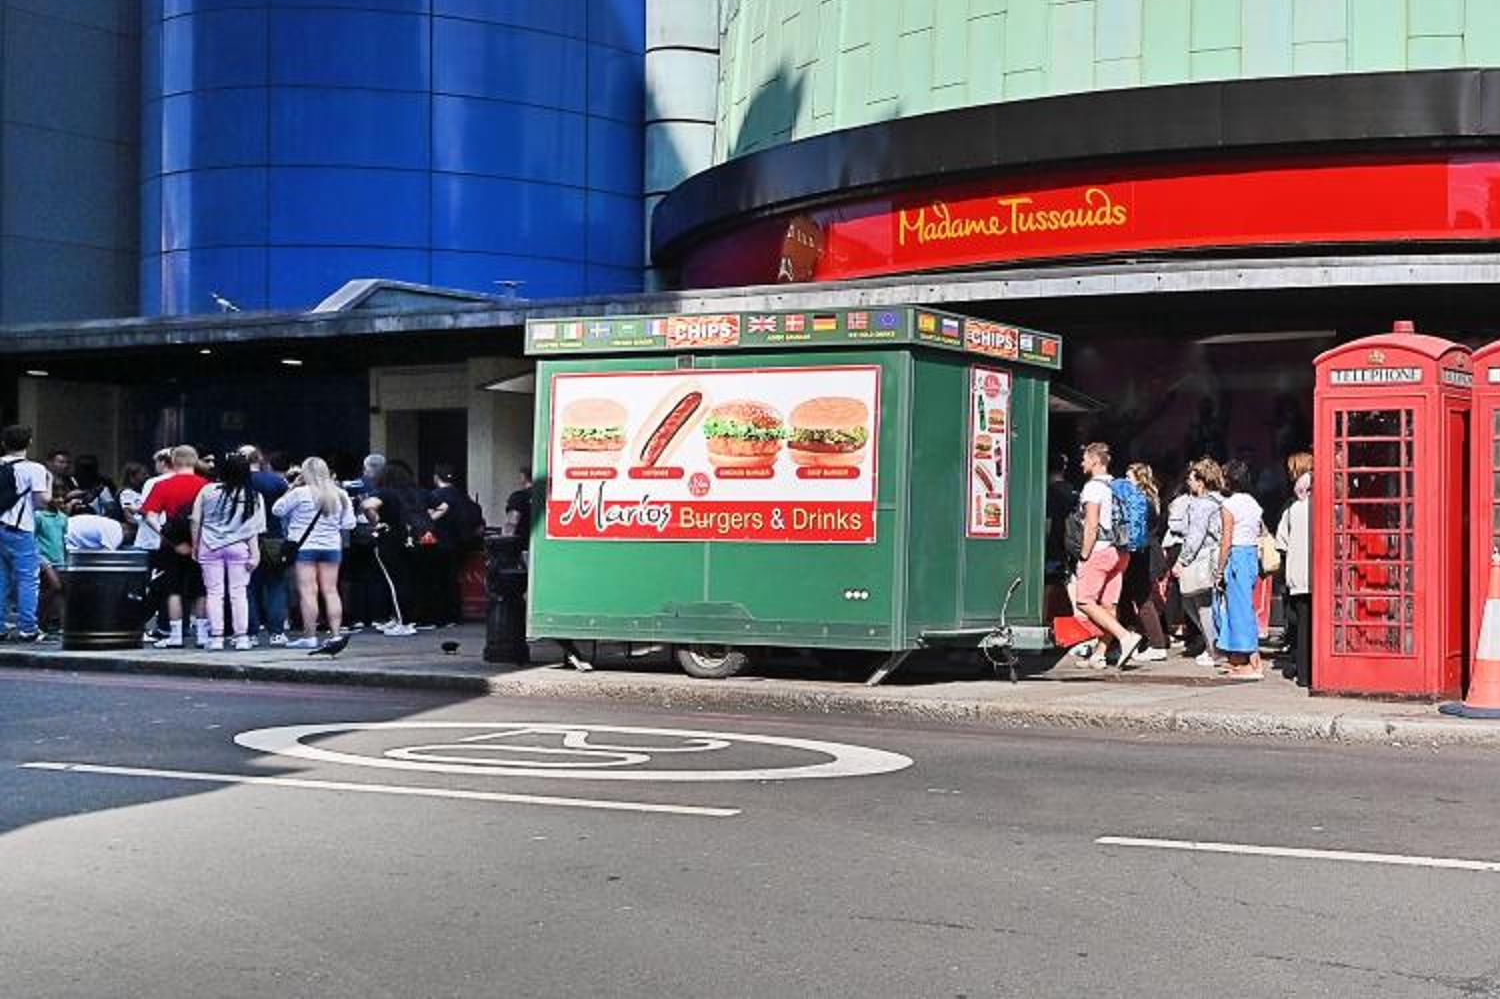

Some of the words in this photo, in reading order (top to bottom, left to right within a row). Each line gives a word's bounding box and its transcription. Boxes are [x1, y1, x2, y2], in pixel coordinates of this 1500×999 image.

[898, 201, 1008, 246] Madame
[998, 188, 1128, 234] Tussauds
[674, 322, 733, 340] CHIPS
[970, 328, 1014, 351] CHIPS
[679, 507, 764, 534] Burgers
[770, 507, 786, 531] &
[793, 507, 862, 531] Drinks
